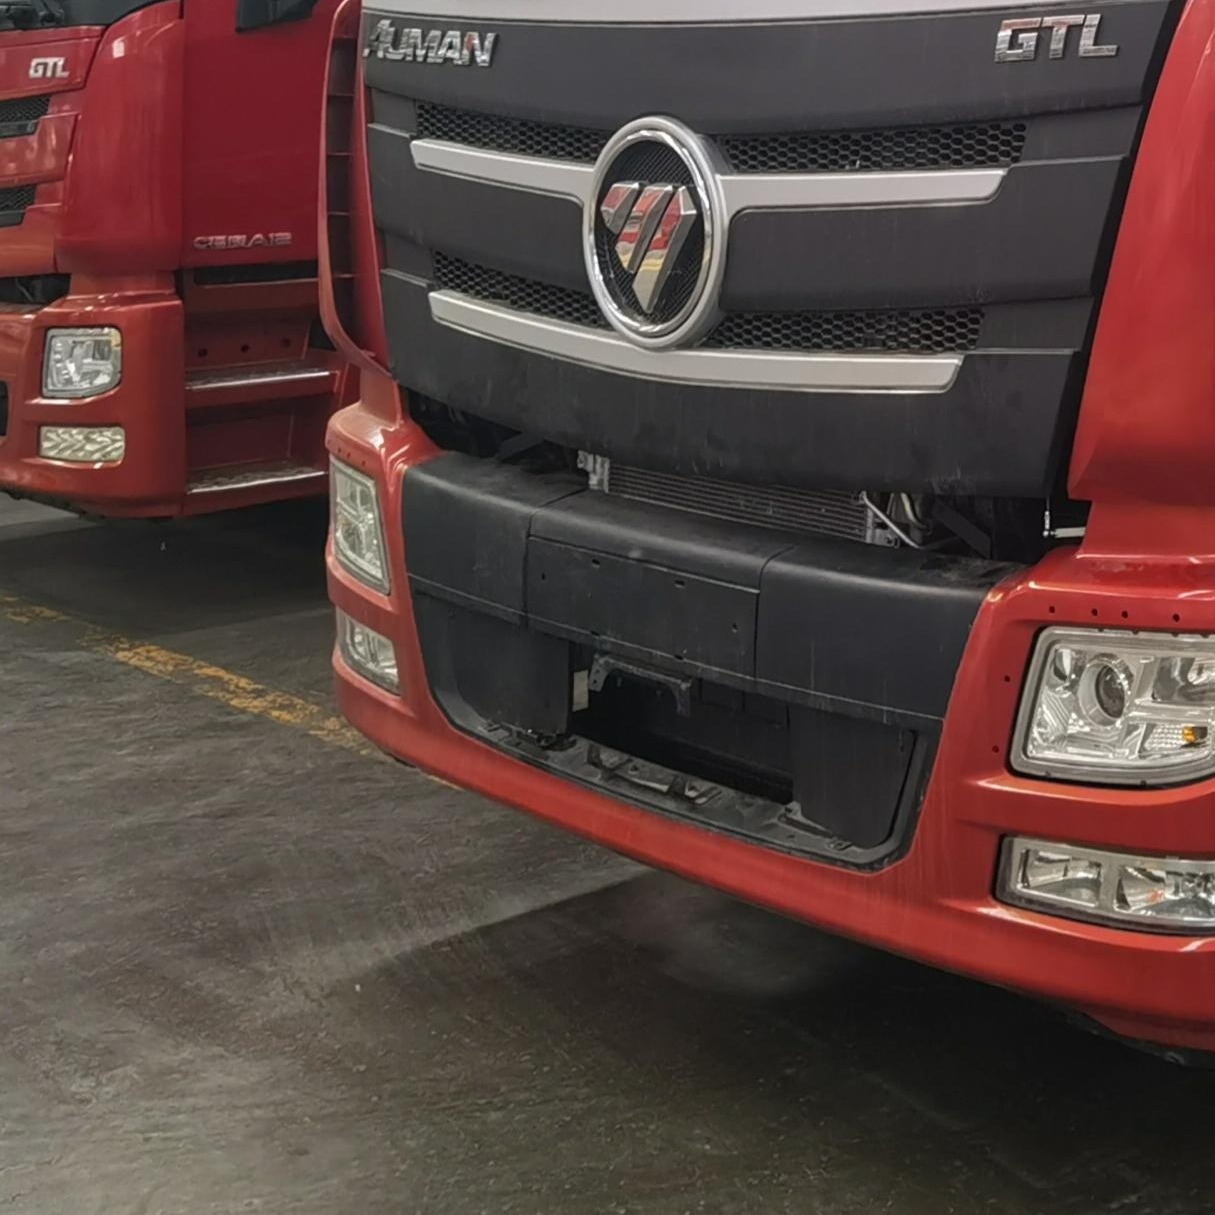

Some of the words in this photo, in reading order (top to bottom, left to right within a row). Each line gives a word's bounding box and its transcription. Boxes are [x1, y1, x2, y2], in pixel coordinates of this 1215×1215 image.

[362, 19, 497, 66] AUMAN
[994, 13, 1118, 62] GTL
[29, 57, 70, 79] GTL
